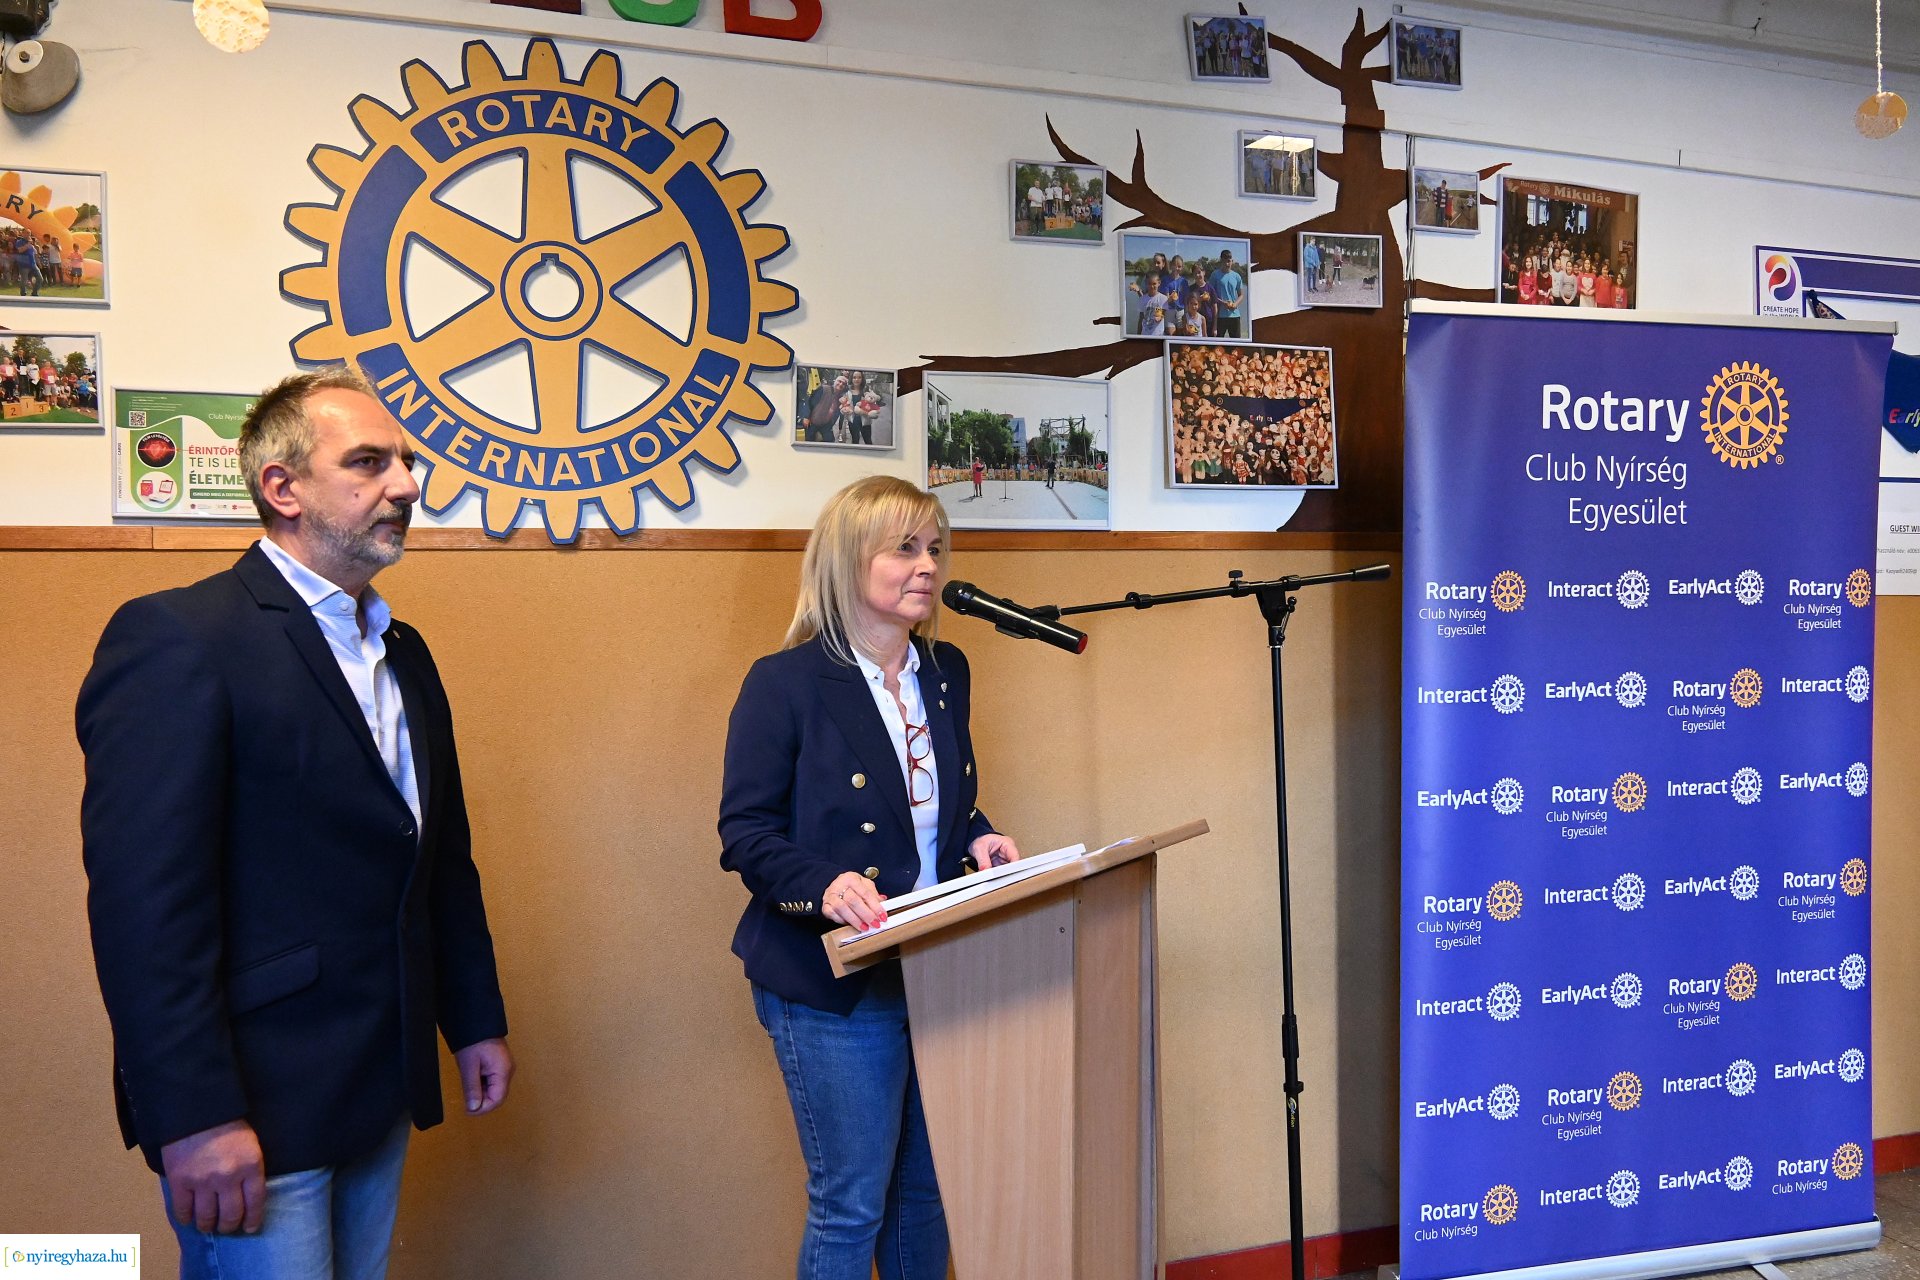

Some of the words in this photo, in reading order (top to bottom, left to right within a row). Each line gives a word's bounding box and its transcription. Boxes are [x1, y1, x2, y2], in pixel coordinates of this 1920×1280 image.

[436, 93, 653, 154] ROTARY
[1554, 186, 1611, 205] Mikulás
[0, 194, 44, 220] RY
[1763, 305, 1783, 313] CREATE
[1727, 373, 1764, 386] ROTARY
[11, 407, 17, 416] 2
[1543, 384, 1689, 442] Rotary
[376, 368, 731, 488] INTERNATIONAL
[1714, 430, 1776, 458] INTERNATIONAL
[189, 457, 203, 467] TE
[208, 458, 219, 467] IS
[1526, 453, 1587, 481] Club
[1597, 454, 1686, 489] Nyírség
[1570, 497, 1687, 531] Egyesület
[1426, 582, 1487, 603] Rotary
[1549, 581, 1612, 597] Interact
[1669, 578, 1731, 598] EarlyAct
[1789, 579, 1842, 599] Rotary
[1419, 608, 1445, 619] Club
[1450, 608, 1486, 621] Nyírség
[1784, 604, 1805, 614] Club
[1808, 604, 1841, 616] Nyírség
[1438, 624, 1486, 638] Egyesület
[1798, 618, 1841, 631] Egyesület
[1546, 682, 1612, 701] EarlyAct
[1673, 681, 1726, 699] Rotary
[1782, 678, 1842, 693] Interact
[1418, 687, 1487, 703] Interact
[1668, 705, 1689, 716] Club
[1692, 704, 1725, 717] Nyírség
[1683, 720, 1725, 733] Egyesület
[1668, 780, 1728, 796] Interact
[1780, 773, 1842, 791] EarlyAct
[1418, 789, 1488, 809] EarlyAct
[1552, 786, 1608, 804] Rotary
[1546, 811, 1569, 822] Club
[1572, 810, 1607, 823] Nyírség
[1562, 825, 1607, 839] Egyesület
[1665, 876, 1726, 896] EarlyAct
[1784, 872, 1836, 889] Rotary
[1545, 886, 1608, 904] Interact
[1778, 896, 1799, 906] Club
[1802, 894, 1835, 907] Nyírség
[1424, 896, 1482, 914] Rotary
[1792, 909, 1835, 922] Egyesület
[1417, 921, 1442, 932] Club
[1447, 919, 1481, 933] Nyírség
[1436, 935, 1481, 950] Egyesület
[1777, 967, 1835, 984] Interact
[1542, 984, 1607, 1005] EarlyAct
[1669, 979, 1721, 995] Rotary
[1417, 996, 1483, 1016] Interact
[1663, 1003, 1685, 1014] Club
[1688, 1000, 1720, 1014] Nyírség
[1678, 1015, 1719, 1030] Egyesület
[1775, 1059, 1835, 1079] EarlyAct
[1663, 1073, 1722, 1093] Interact
[1548, 1088, 1602, 1106] Rotary
[1416, 1096, 1483, 1118] EarlyAct
[1542, 1113, 1564, 1125] Club
[1568, 1110, 1601, 1124] Nyírség
[1558, 1125, 1601, 1141] Egyesület
[1778, 1159, 1828, 1176] Rotary
[1659, 1168, 1721, 1190] EarlyAct
[1772, 1183, 1793, 1194] Club
[1796, 1179, 1827, 1193] Nyírség
[1541, 1184, 1602, 1206] Interact
[1421, 1202, 1478, 1222] Rotary
[1415, 1229, 1438, 1241] Club
[1442, 1224, 1477, 1239] Nyírség
